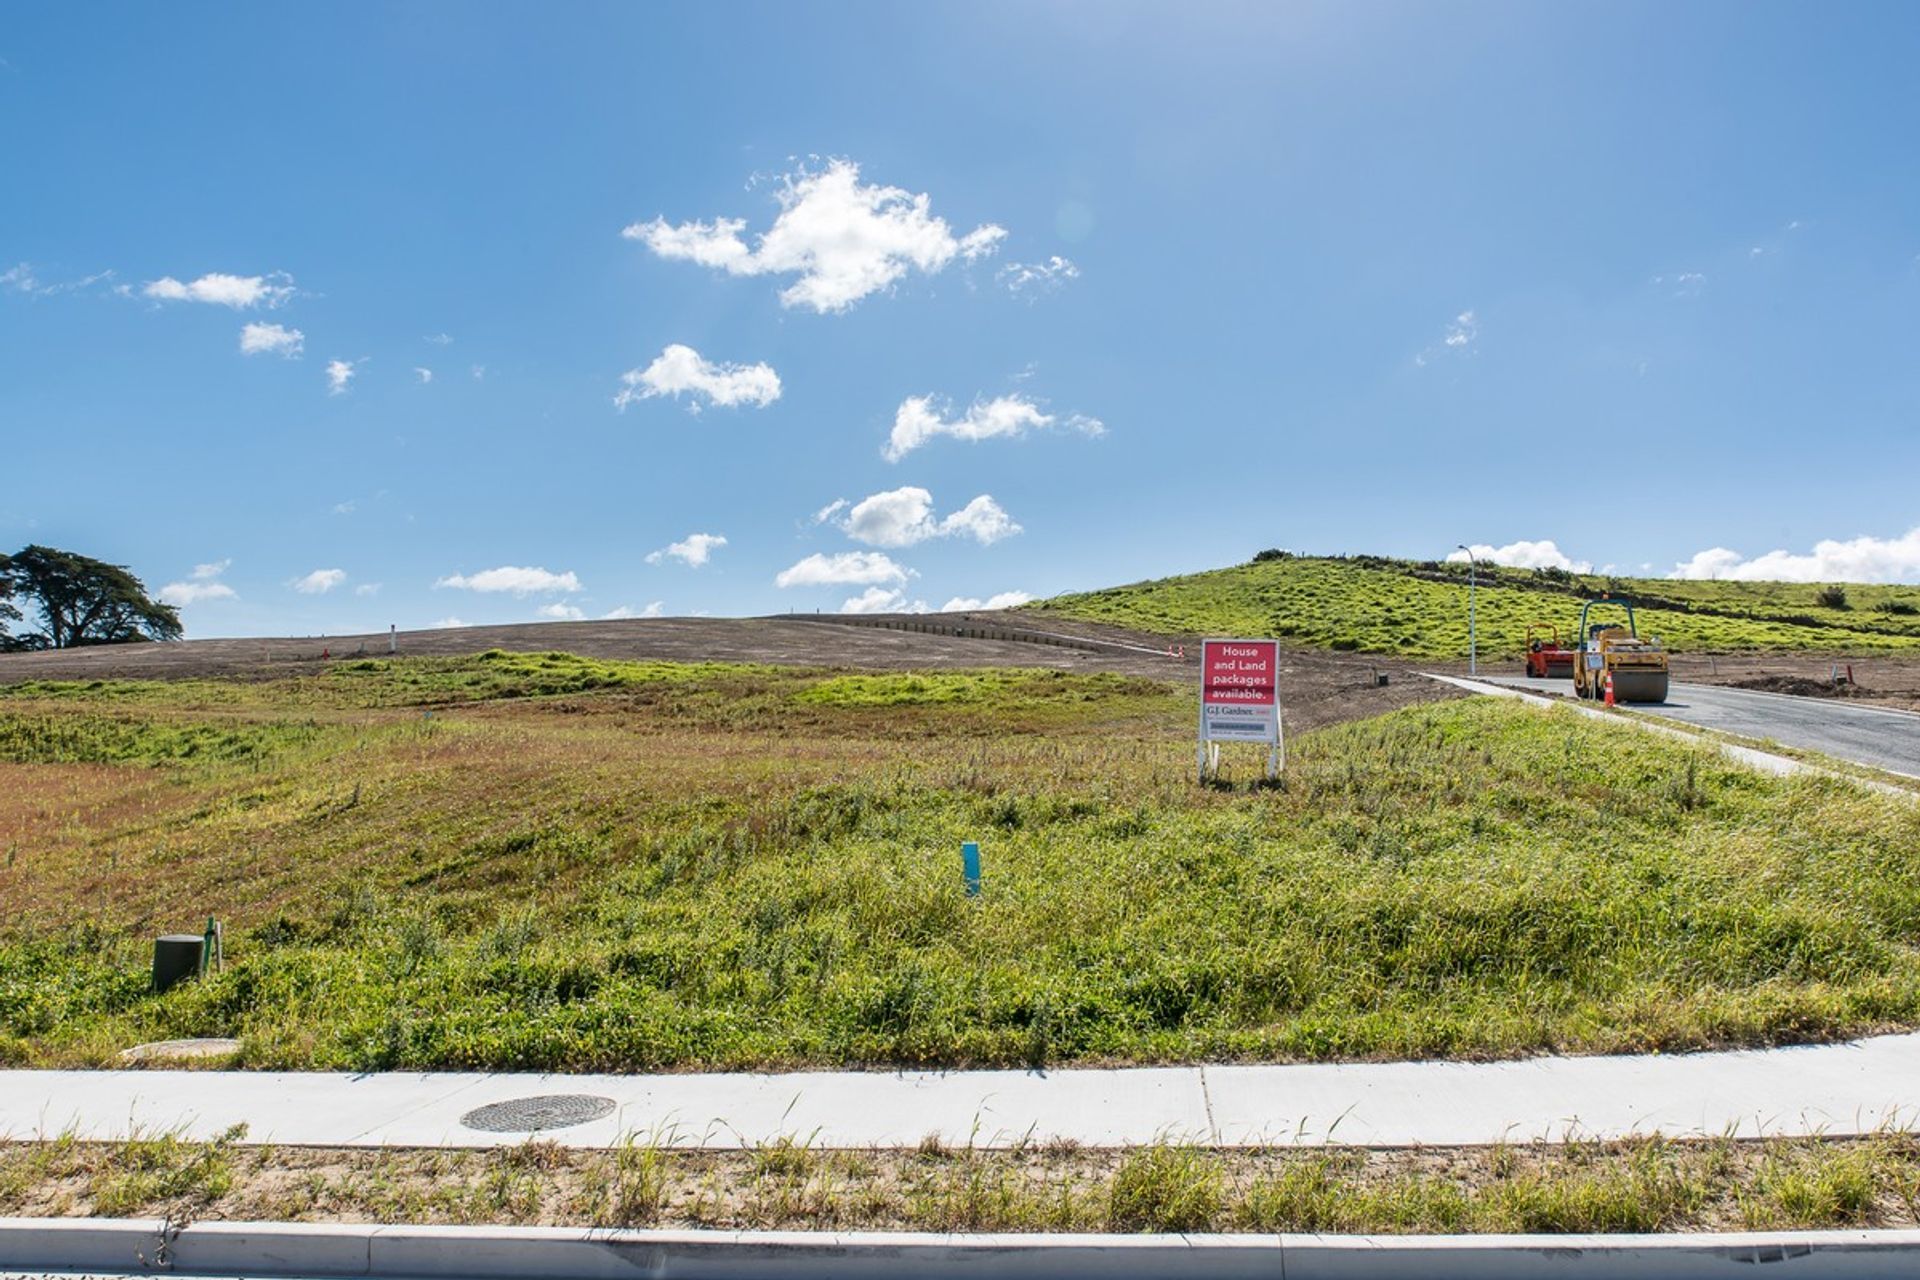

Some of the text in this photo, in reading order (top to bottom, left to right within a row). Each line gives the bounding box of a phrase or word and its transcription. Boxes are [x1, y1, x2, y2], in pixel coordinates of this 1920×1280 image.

[1222, 646, 1258, 656] House
[1214, 660, 1266, 670] and Land
[1213, 674, 1267, 687] packages
[1212, 689, 1266, 699] available.
